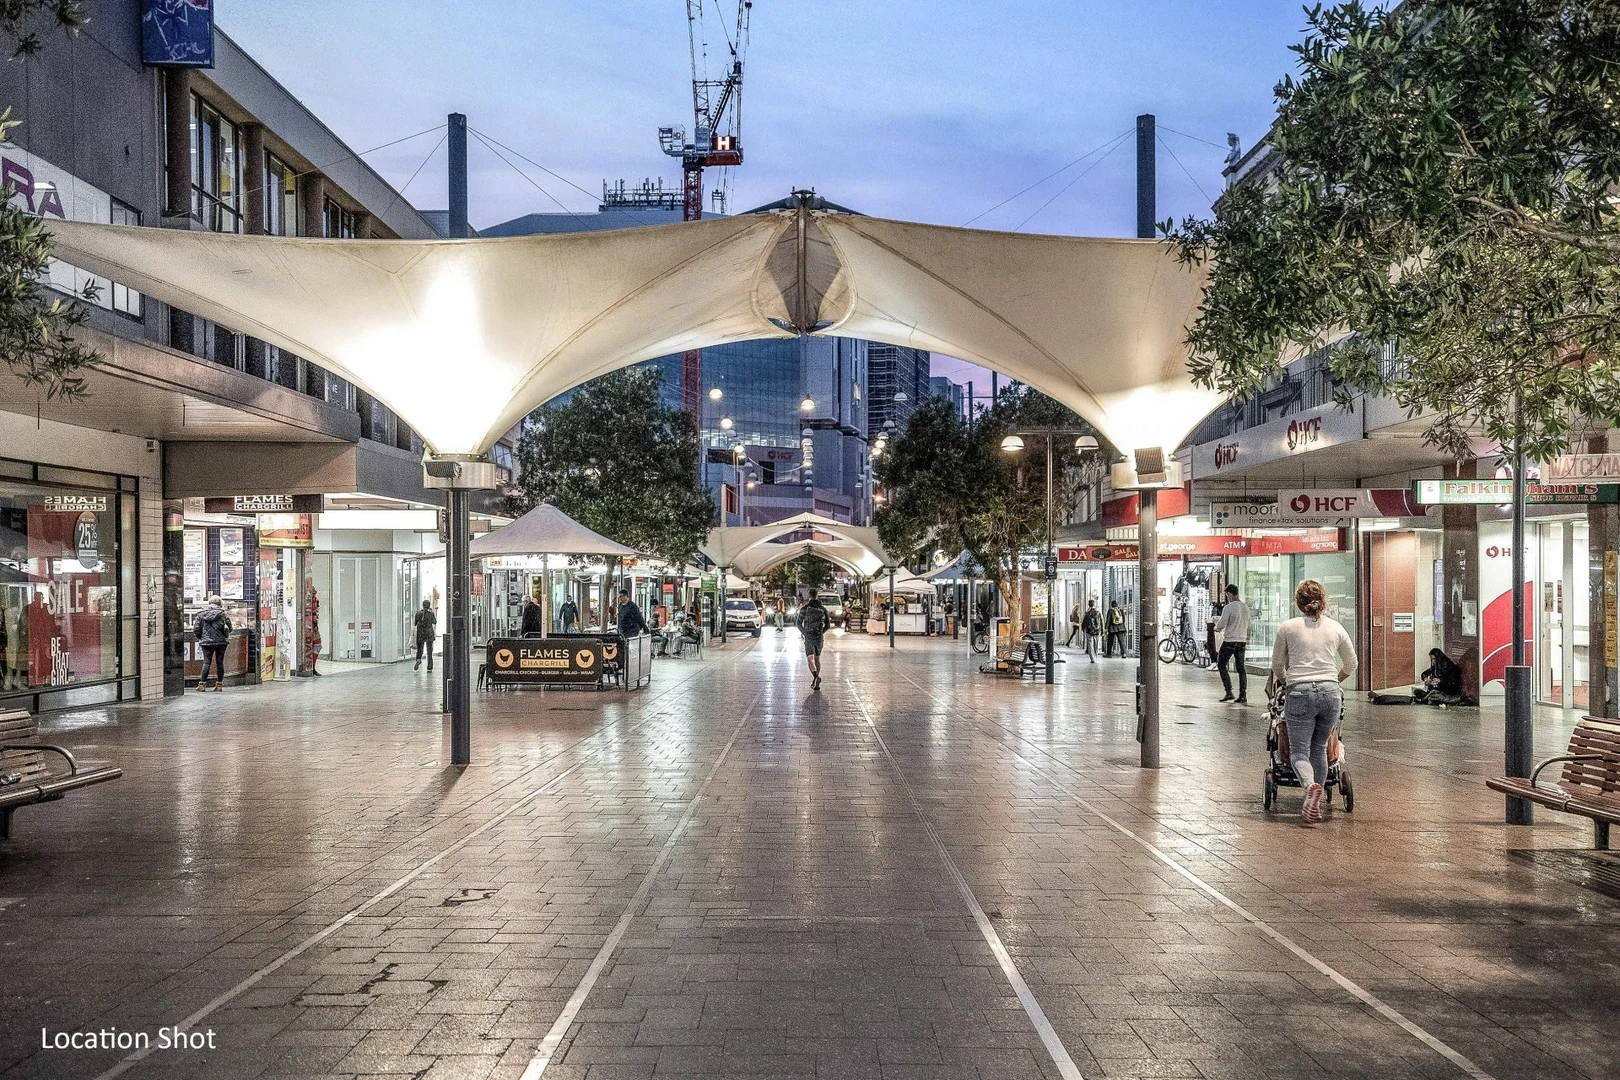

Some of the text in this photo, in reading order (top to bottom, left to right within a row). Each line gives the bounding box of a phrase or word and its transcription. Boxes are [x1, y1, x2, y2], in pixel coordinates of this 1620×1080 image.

[717, 136, 730, 151] H
[1299, 417, 1321, 445] HCF
[1222, 442, 1239, 465] HCF
[234, 495, 294, 503] FLAMES
[1314, 496, 1358, 512] HCF
[1249, 517, 1275, 525] finance
[1114, 548, 1131, 556] SALE
[47, 580, 84, 615] SALE
[51, 637, 62, 657] BE
[520, 649, 570, 658] FLAMES
[52, 652, 70, 672] THAT
[51, 669, 69, 686] GIRL
